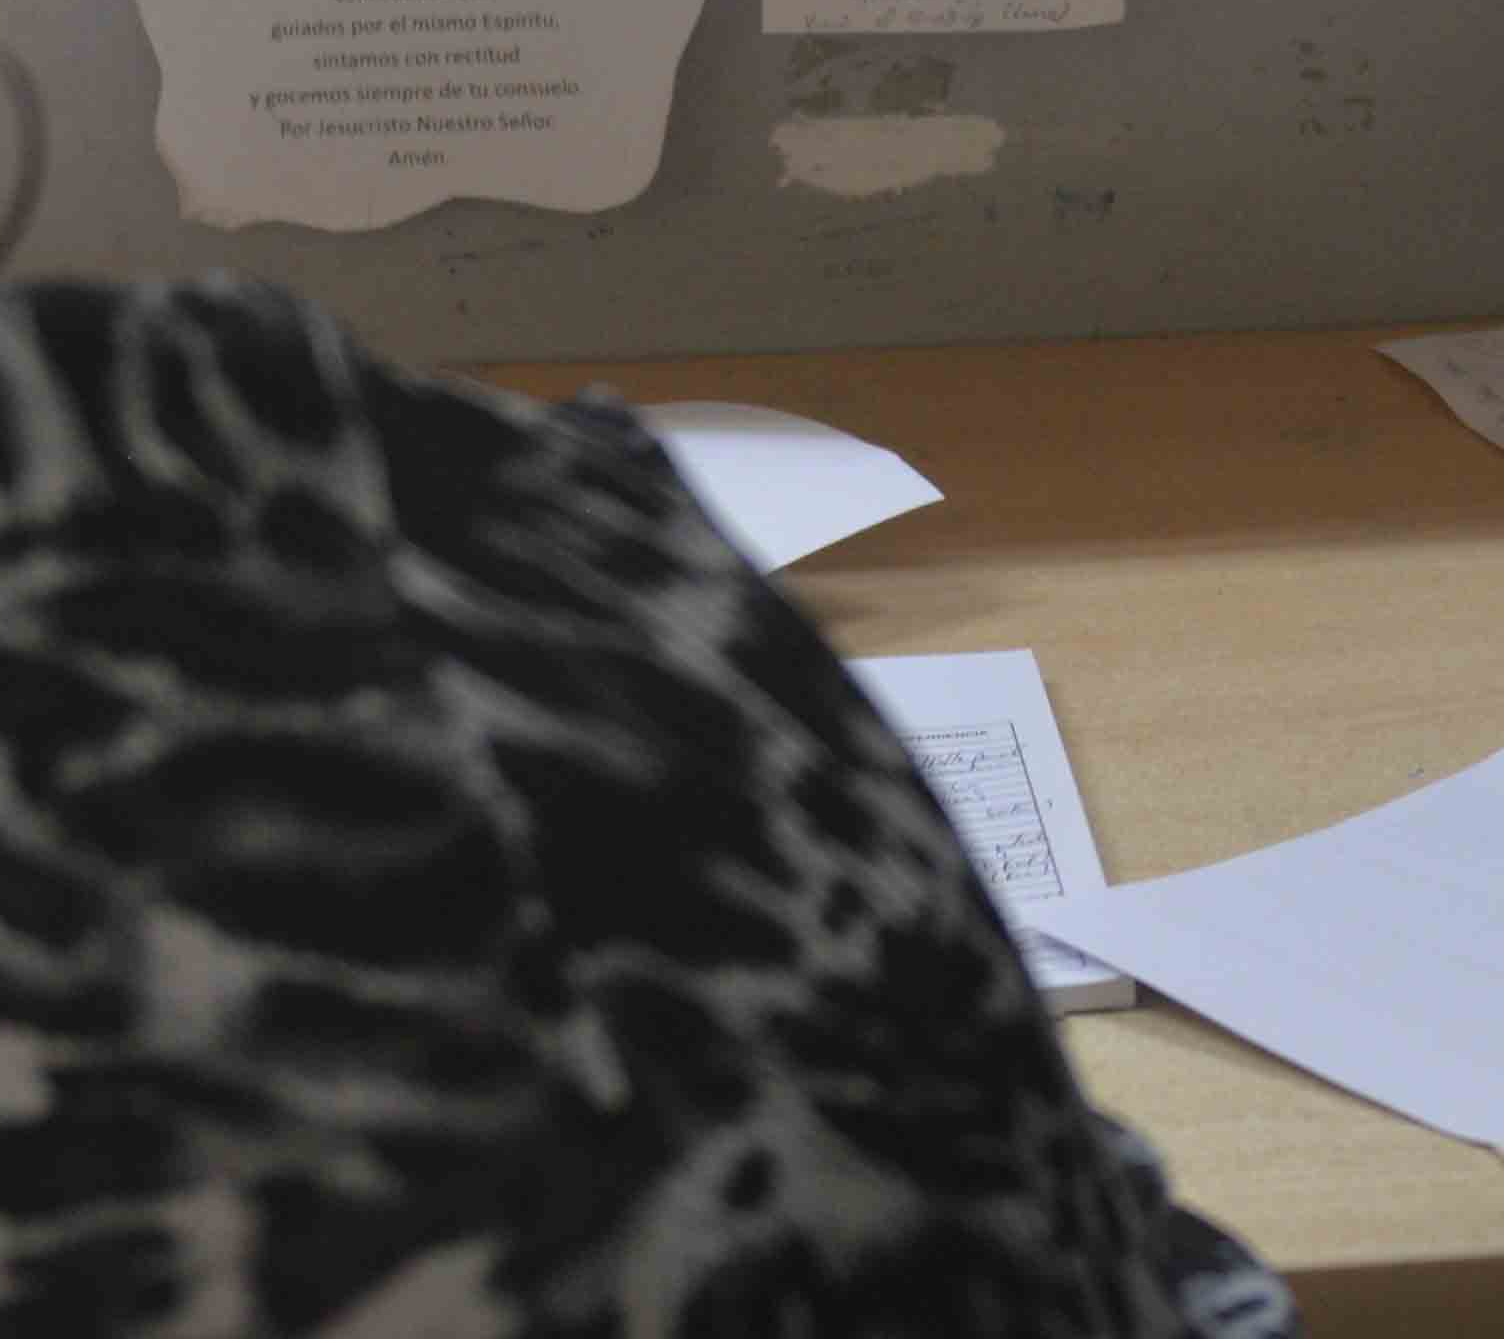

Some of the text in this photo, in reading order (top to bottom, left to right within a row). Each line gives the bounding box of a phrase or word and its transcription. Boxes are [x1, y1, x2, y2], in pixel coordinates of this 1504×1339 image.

[351, 18, 384, 39] por
[388, 14, 407, 36] el
[404, 50, 440, 68] con
[248, 93, 261, 111] y
[439, 80, 466, 100] de
[467, 82, 489, 100] tu
